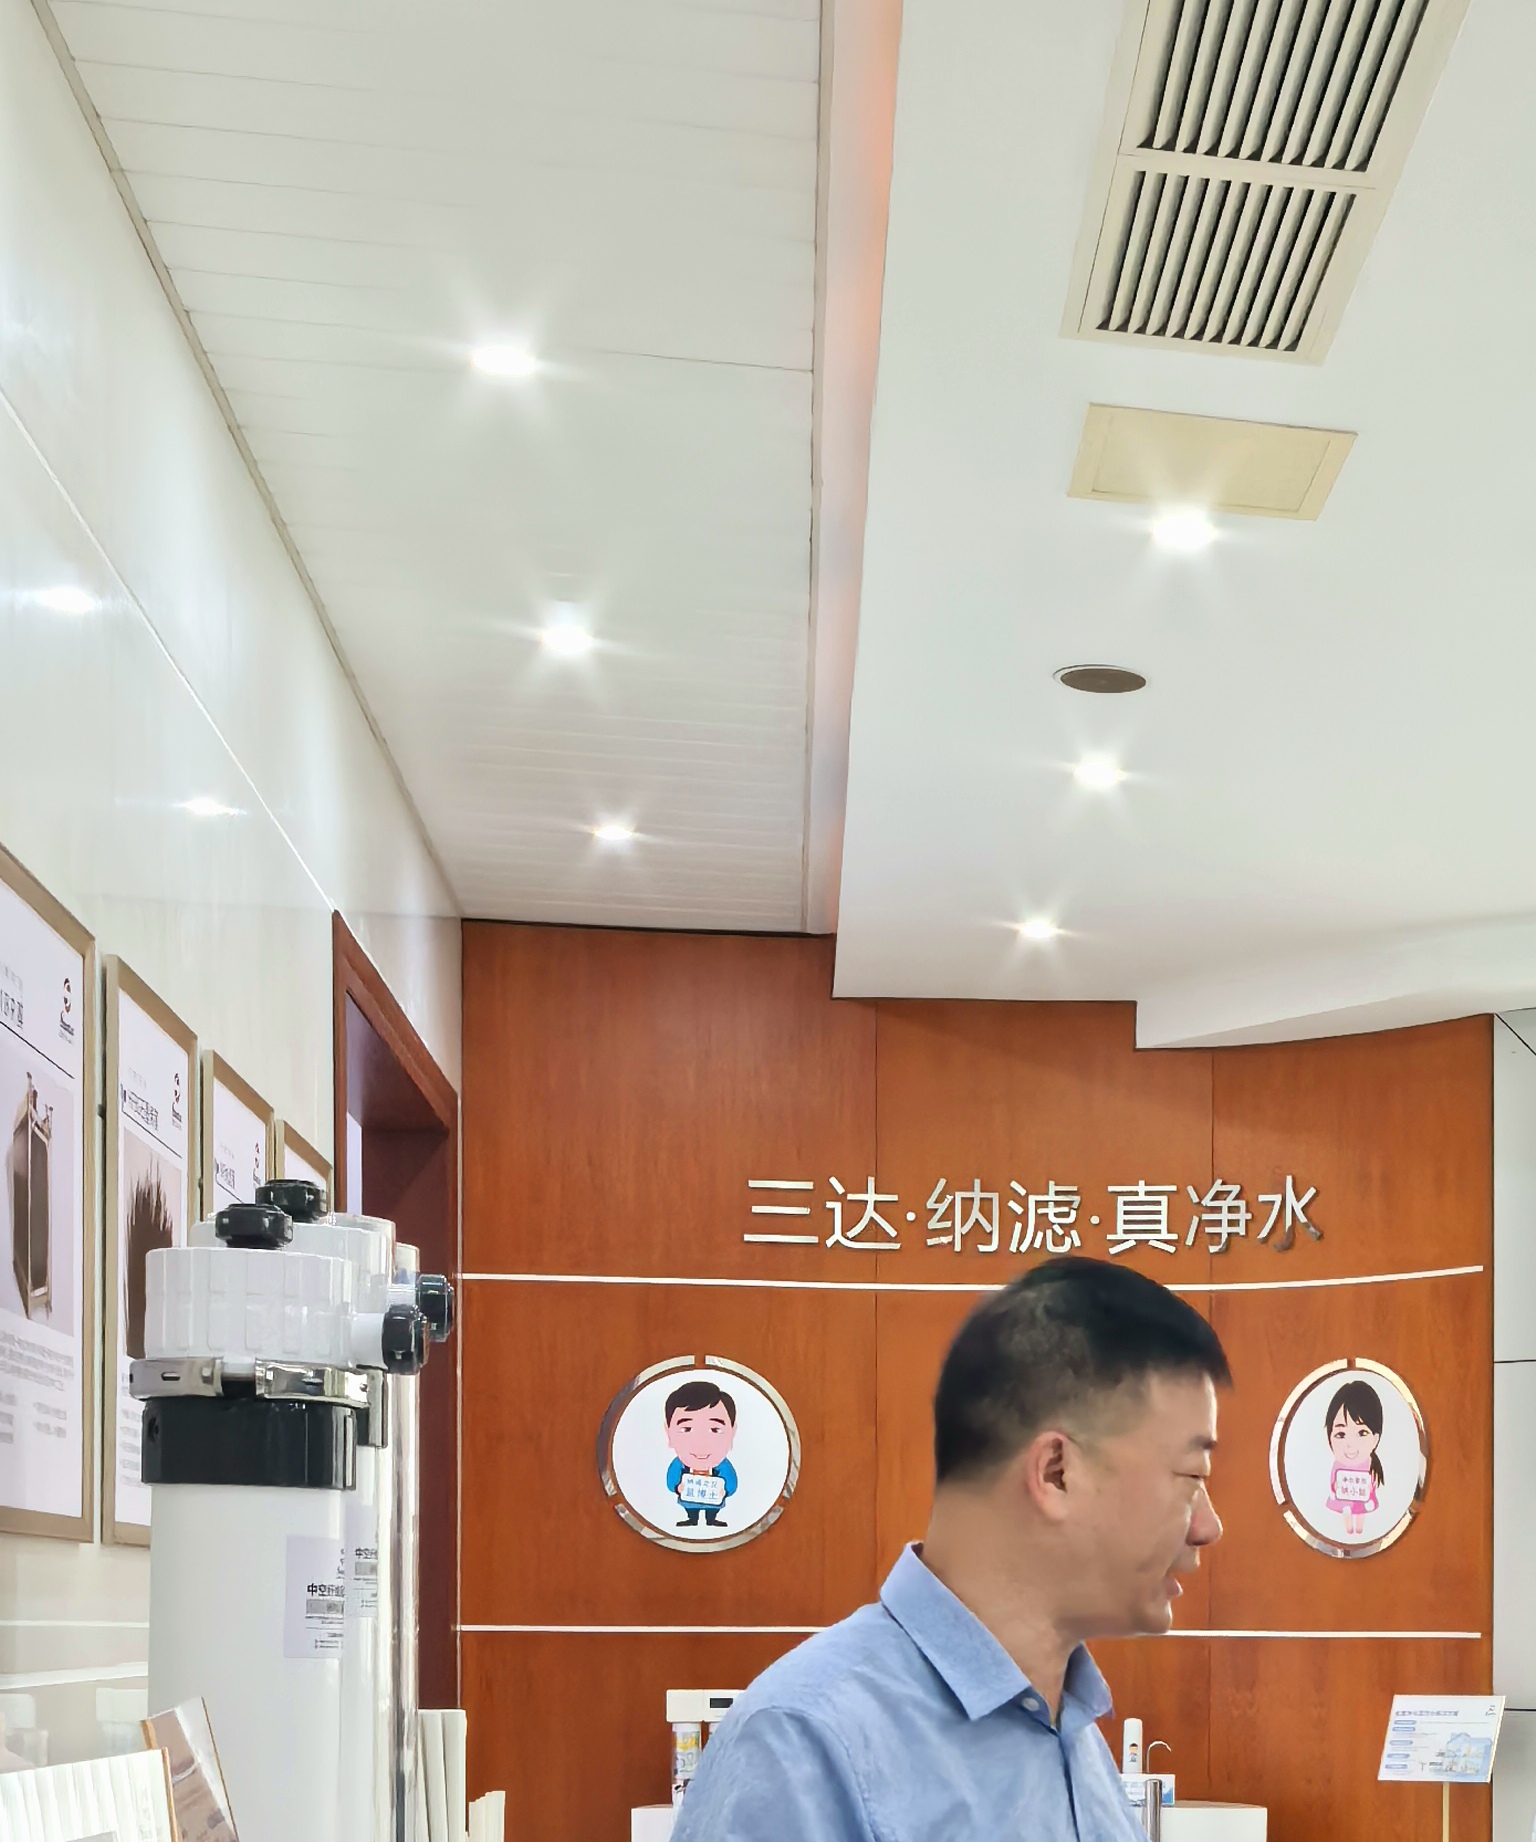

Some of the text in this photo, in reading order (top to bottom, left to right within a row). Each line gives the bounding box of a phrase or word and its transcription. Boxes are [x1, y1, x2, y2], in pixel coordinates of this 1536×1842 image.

[743, 1174, 1325, 1255] 三达·纳滤·真净水
